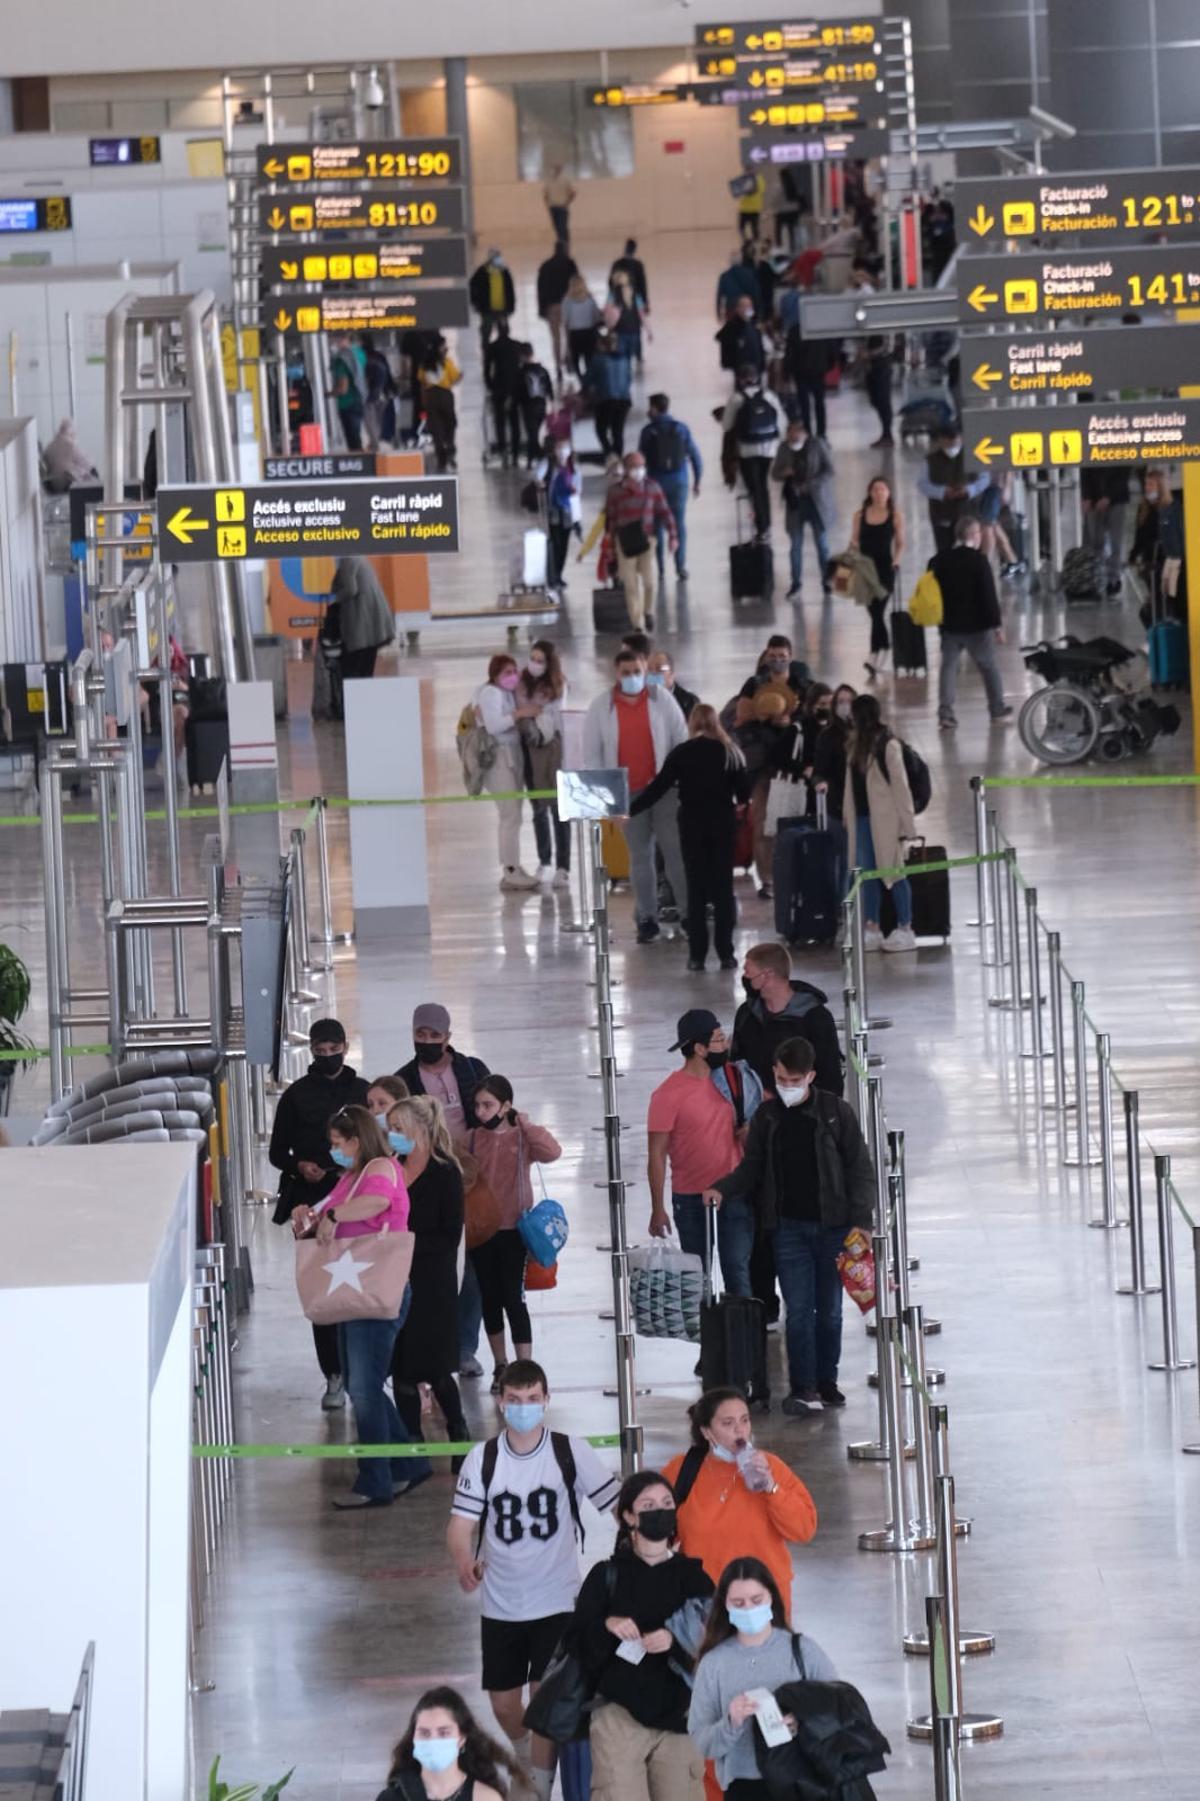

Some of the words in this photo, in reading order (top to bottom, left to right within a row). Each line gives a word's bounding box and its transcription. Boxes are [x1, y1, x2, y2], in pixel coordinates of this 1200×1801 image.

[1040, 184, 1108, 202] Facturació
[1041, 202, 1091, 216] Check-in
[1123, 195, 1181, 227] 121
[1041, 213, 1118, 232] Facturación
[1043, 261, 1113, 279] Facturació
[1043, 280, 1095, 294] Check-in
[1128, 273, 1187, 306] 141
[1044, 291, 1122, 310] Facturación
[1008, 343, 1044, 360] Carril
[1048, 342, 1083, 360] ràpid
[1009, 360, 1034, 374] Fast
[1036, 359, 1062, 373] lane
[1009, 373, 1046, 391] Carril
[1050, 371, 1093, 390] rápido
[1089, 414, 1128, 430] Accés
[1132, 412, 1186, 429] exclusiu
[1088, 430, 1141, 445] Exclusive
[1143, 429, 1183, 442] access
[1090, 446, 1137, 461] Acceso
[1141, 443, 1200, 459] exclusivo
[267, 460, 334, 478] SECURE
[253, 499, 291, 515] Accés
[294, 496, 346, 513] exclusiu
[370, 494, 405, 511] Carril
[409, 492, 443, 511] ràpid
[253, 514, 302, 529] Exclusive
[304, 513, 341, 527] access
[370, 511, 394, 524] Fast
[396, 510, 420, 523] lane
[254, 529, 299, 544] Acceso
[303, 526, 360, 542] exclusivo
[372, 524, 407, 539] Carril
[410, 522, 450, 541] rápido
[492, 1485, 559, 1545] 89
